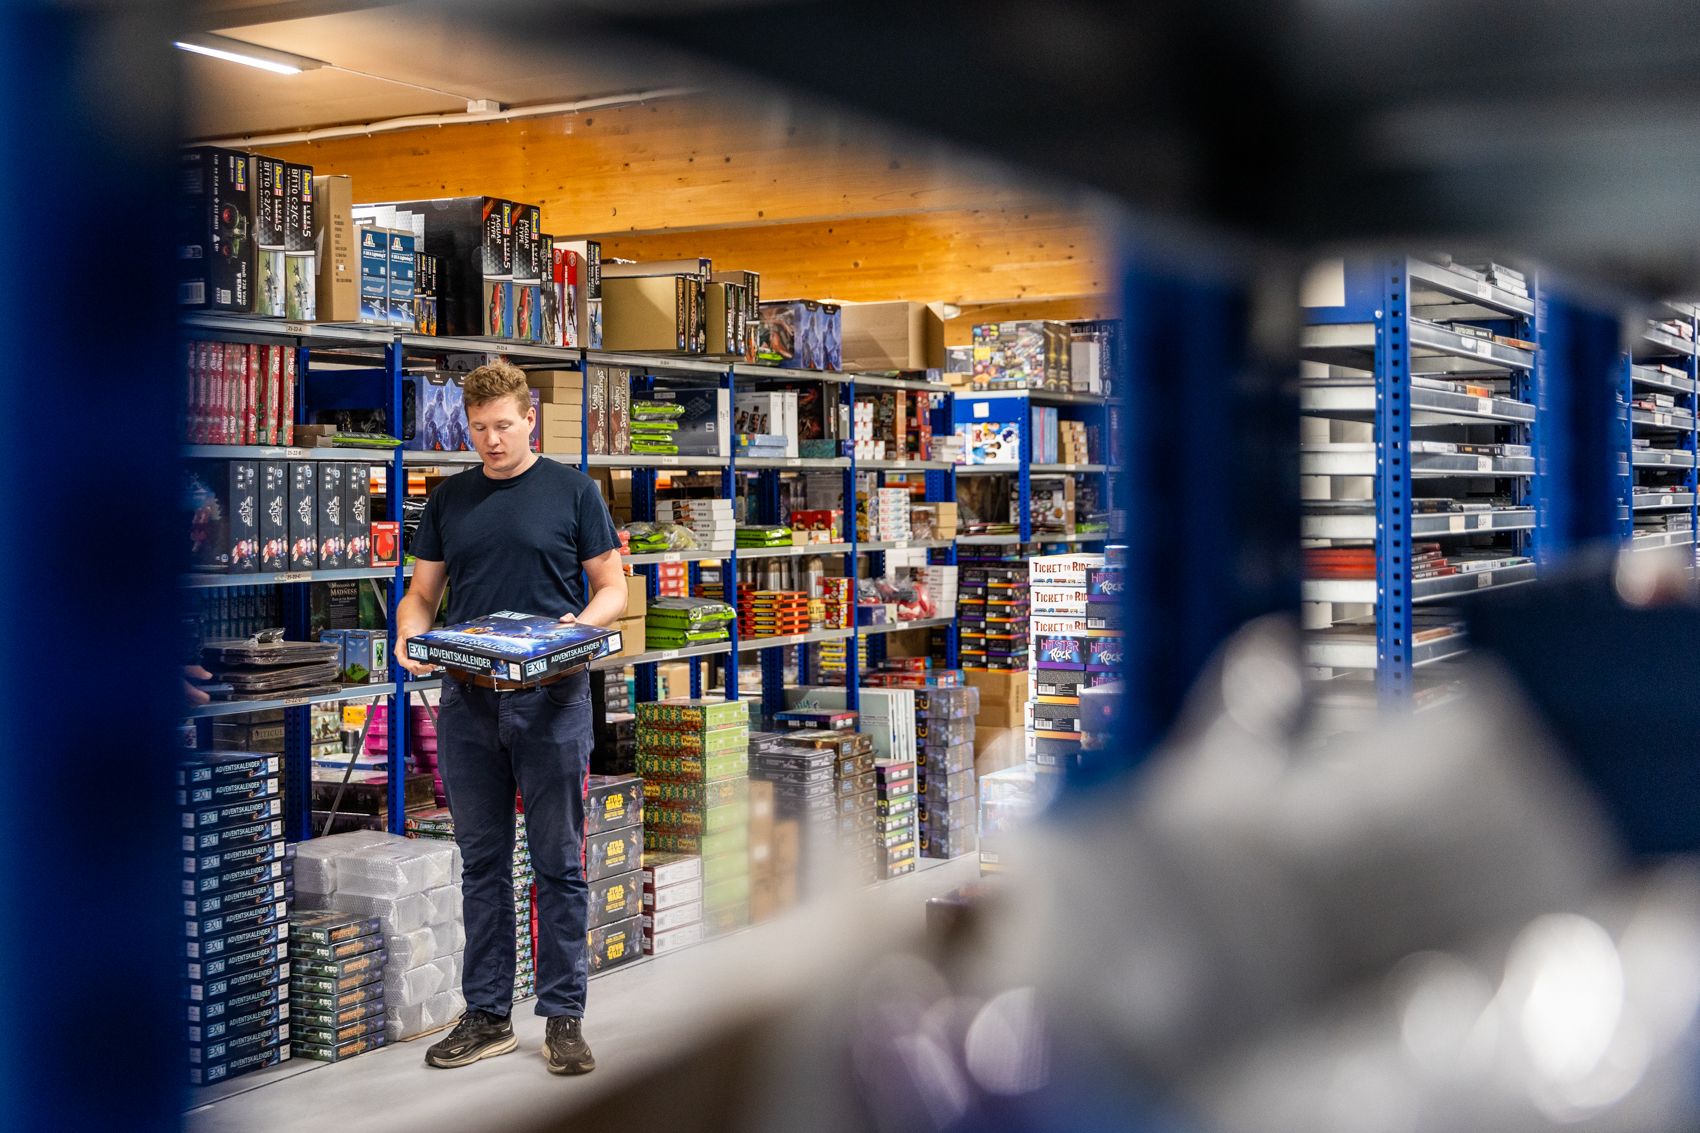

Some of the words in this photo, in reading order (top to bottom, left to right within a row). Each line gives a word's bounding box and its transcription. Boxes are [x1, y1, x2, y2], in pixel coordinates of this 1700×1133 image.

[303, 173, 311, 194] Revell
[263, 190, 271, 221] C-2/C-7
[275, 224, 282, 232] 5
[504, 261, 510, 269] 5
[1033, 562, 1062, 573] TICKET
[330, 588, 357, 596] MADNESS
[1100, 580, 1124, 594] ROCK
[1034, 592, 1064, 602] TICKET
[1075, 592, 1088, 602] RID
[1034, 621, 1064, 632] TICKET
[1040, 640, 1079, 652] HITSTER
[410, 644, 428, 658] EXIT
[430, 648, 491, 668] ADVENTSKALENDER
[528, 660, 546, 672] EXIT
[551, 642, 600, 662] ADVENTSKALENDER
[1049, 648, 1072, 661] ROCK
[1098, 650, 1123, 666] ROCK
[215, 760, 260, 773] ADVENTSKALENDER
[216, 782, 260, 794] ADVENTSKALENDER
[222, 804, 264, 816] ADVENTSKALENDER
[222, 826, 264, 838] ADVENTSKALENDER
[224, 846, 267, 860] ADVENTSKALENDER
[222, 866, 264, 881] ADVENTSKALENDER
[203, 898, 220, 910] EXIT
[224, 887, 267, 902] ADVENTSKALENDER
[204, 918, 222, 932] EXIT
[226, 906, 268, 922] ADVENTSKALENDER
[206, 940, 224, 952] EXIT
[228, 928, 270, 944] ADVENTSKALENDER
[207, 961, 224, 974] EXIT
[228, 948, 270, 964] ADVENTSKALENDER
[209, 982, 227, 994] EXIT
[230, 968, 272, 984] ADVENTSKALENDER
[207, 1003, 224, 1016] EXIT
[228, 990, 270, 1006] ADVENTSKALENDER
[208, 1023, 226, 1036] EXIT
[230, 1010, 272, 1026] ADVENTSKALENDER
[208, 1044, 226, 1057] EXIT
[230, 1030, 272, 1047] ADVENTSKALENDER
[208, 1065, 226, 1079] EXIT
[230, 1051, 272, 1068] ADVENTSKALENDER
